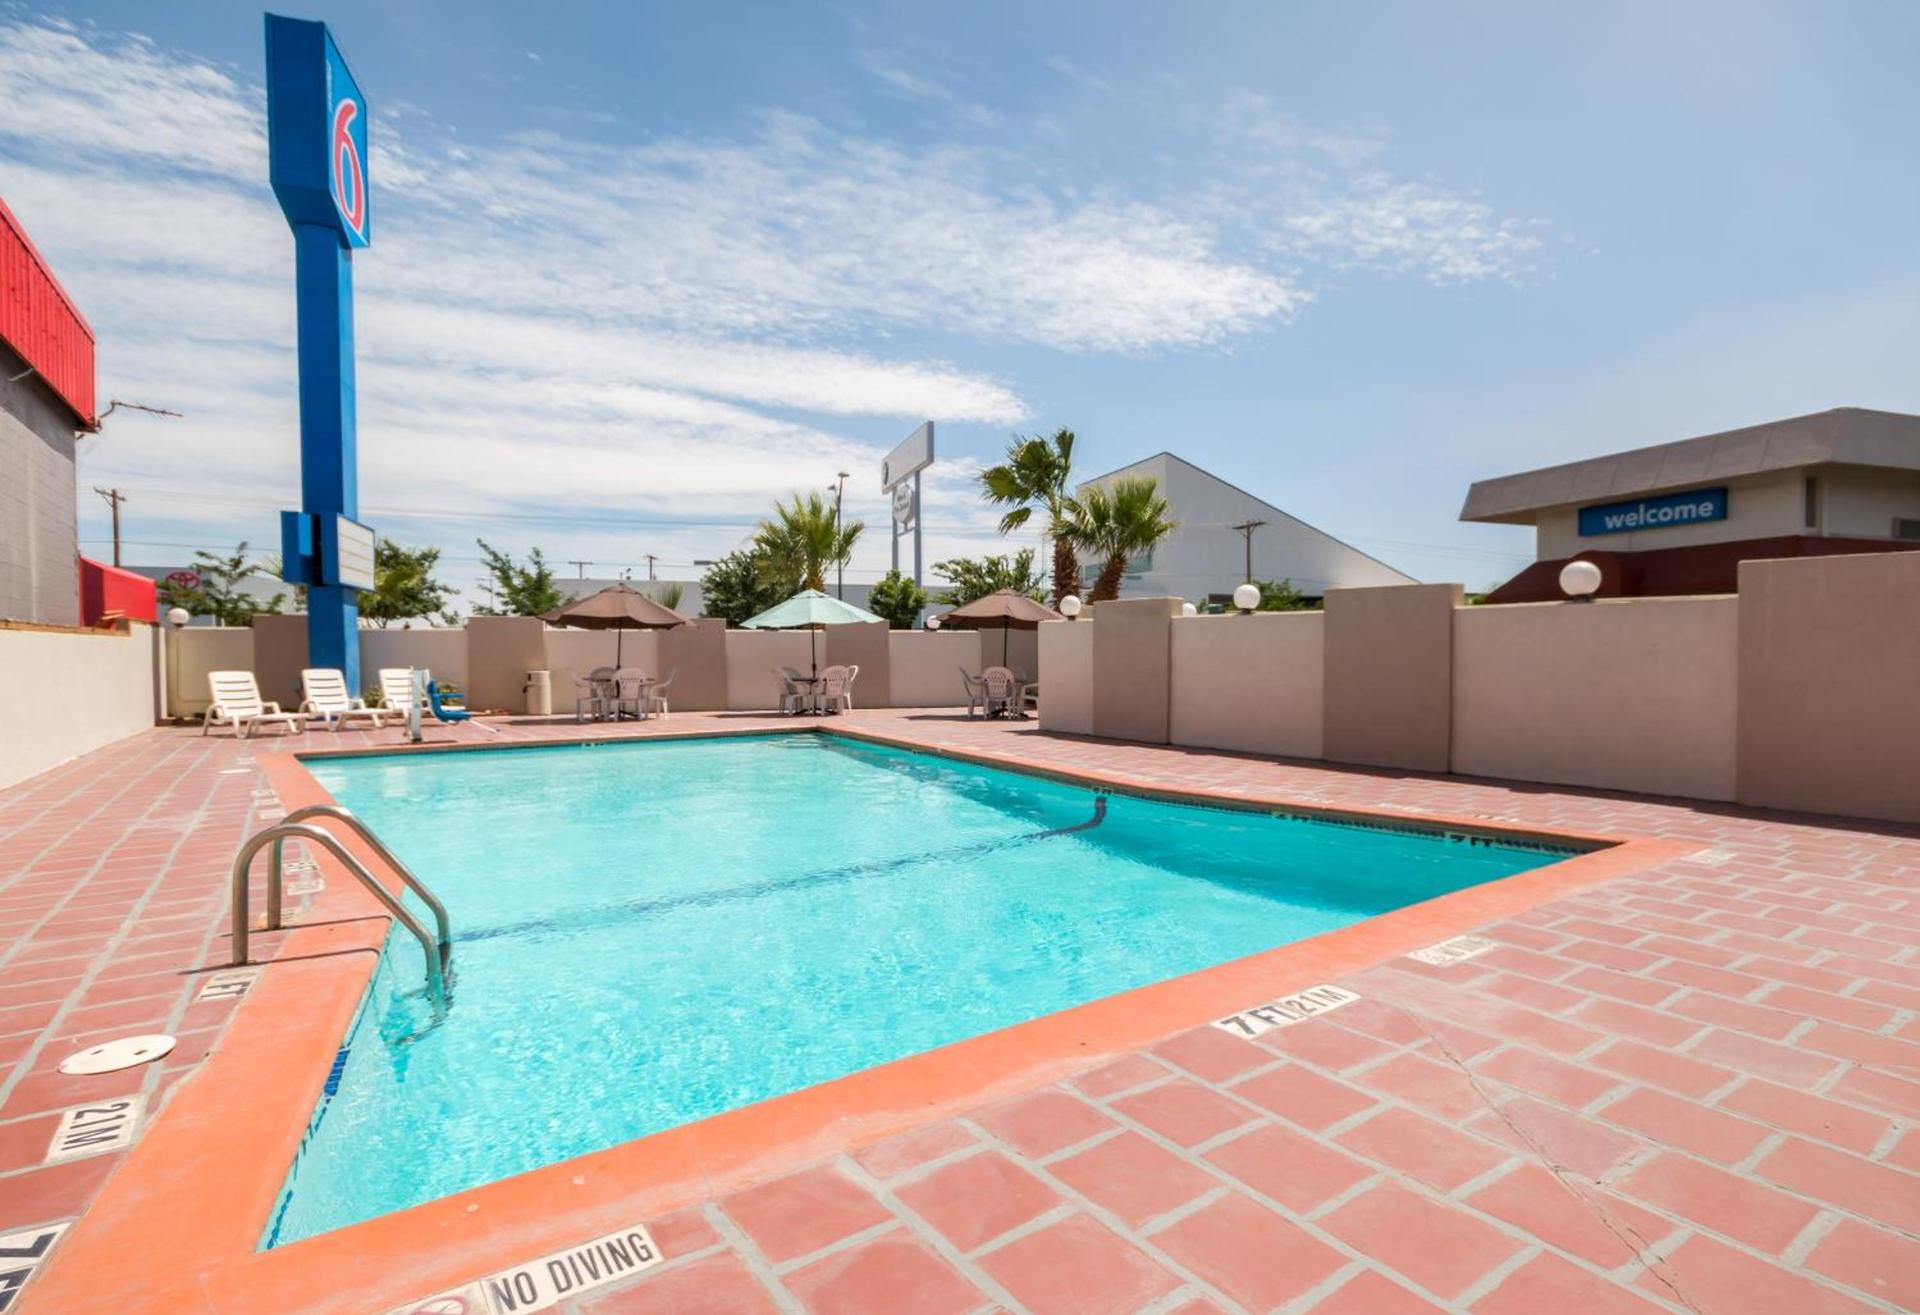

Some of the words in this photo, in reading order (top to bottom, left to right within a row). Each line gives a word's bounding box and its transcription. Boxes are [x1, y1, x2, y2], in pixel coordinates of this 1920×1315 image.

[333, 99, 364, 235] 6
[1604, 501, 1714, 529] welcome
[489, 1271, 538, 1312] NO
[547, 1232, 653, 1293] DIVING
